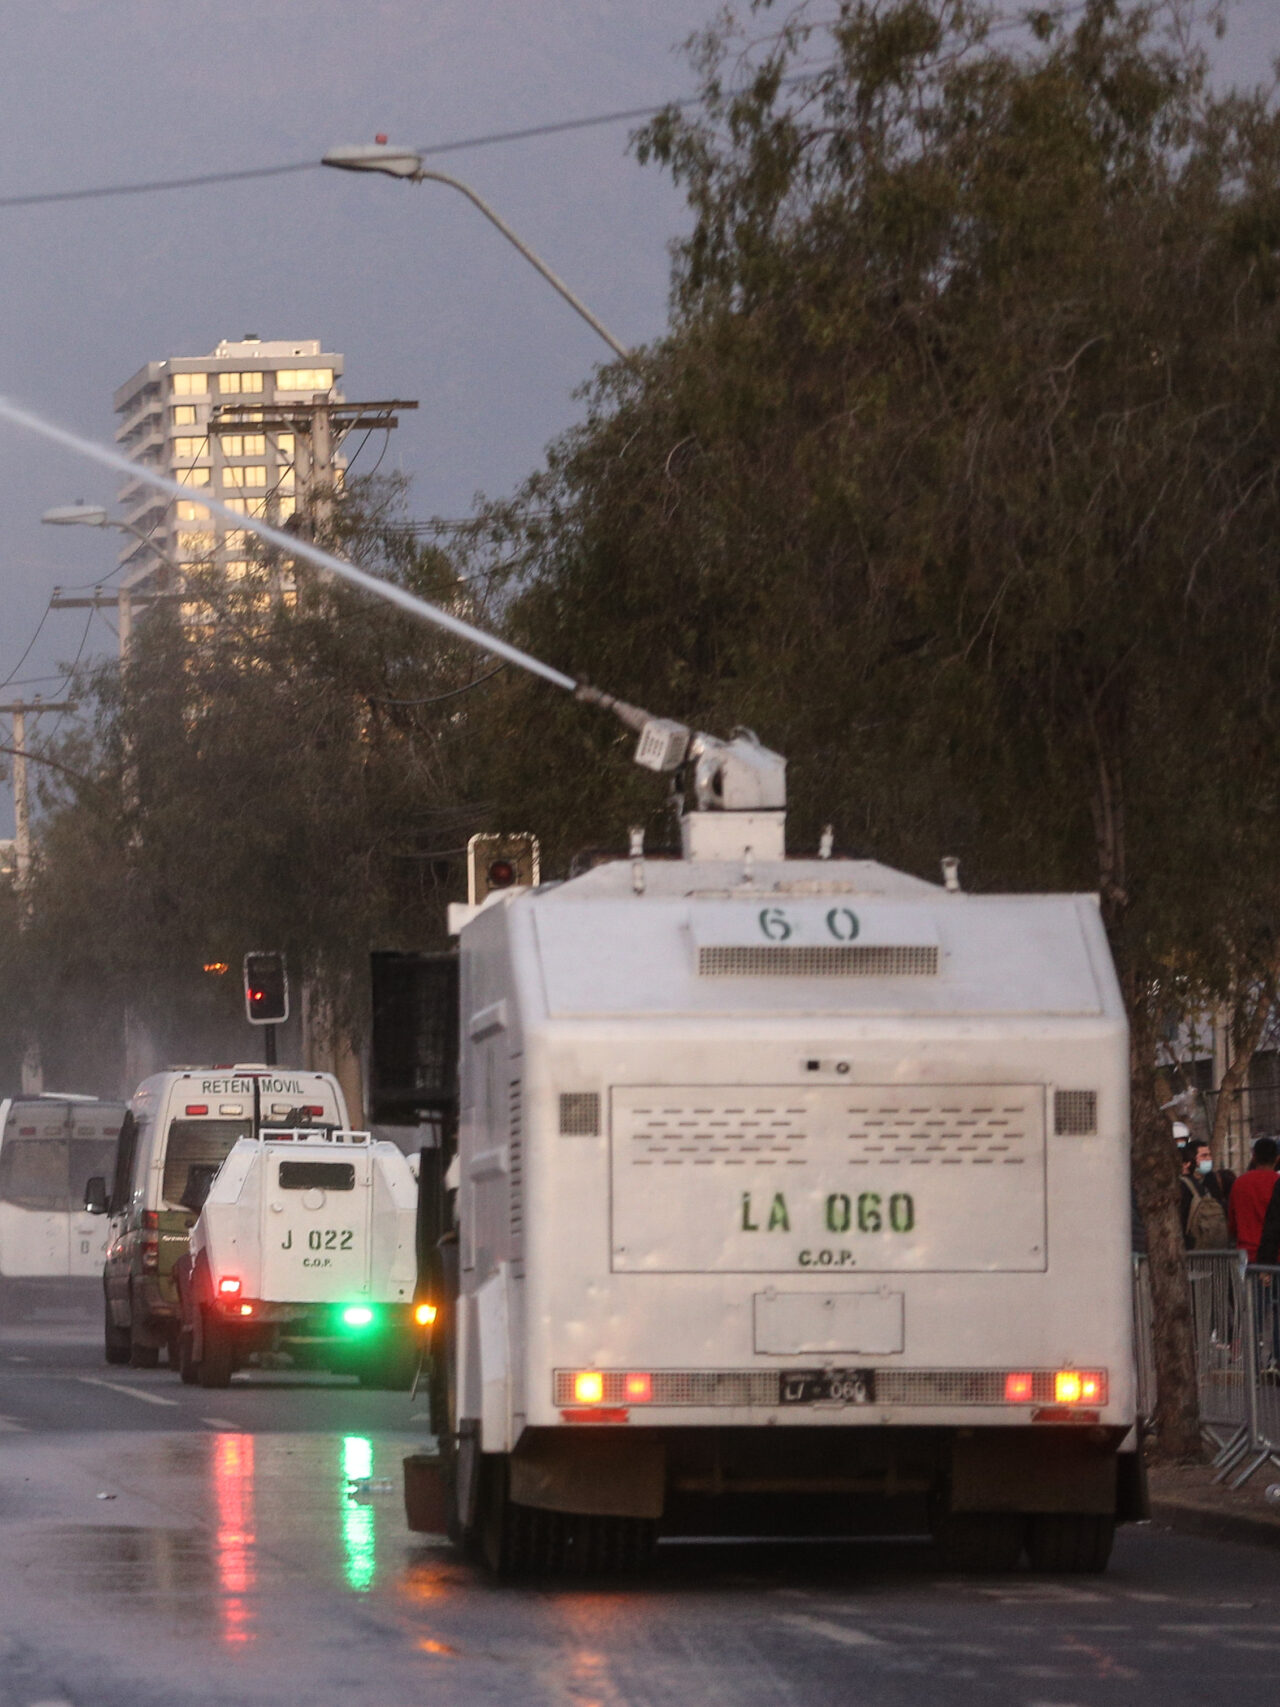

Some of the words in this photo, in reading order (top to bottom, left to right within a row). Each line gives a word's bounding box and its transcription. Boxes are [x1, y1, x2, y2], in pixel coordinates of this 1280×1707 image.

[202, 1080, 250, 1094] RETEN
[261, 1079, 305, 1094] MOVIL
[741, 1191, 791, 1232] LA
[825, 1192, 916, 1233] 060
[281, 1229, 293, 1250] J
[308, 1229, 354, 1251] 022
[798, 1250, 856, 1267] C.O.P.
